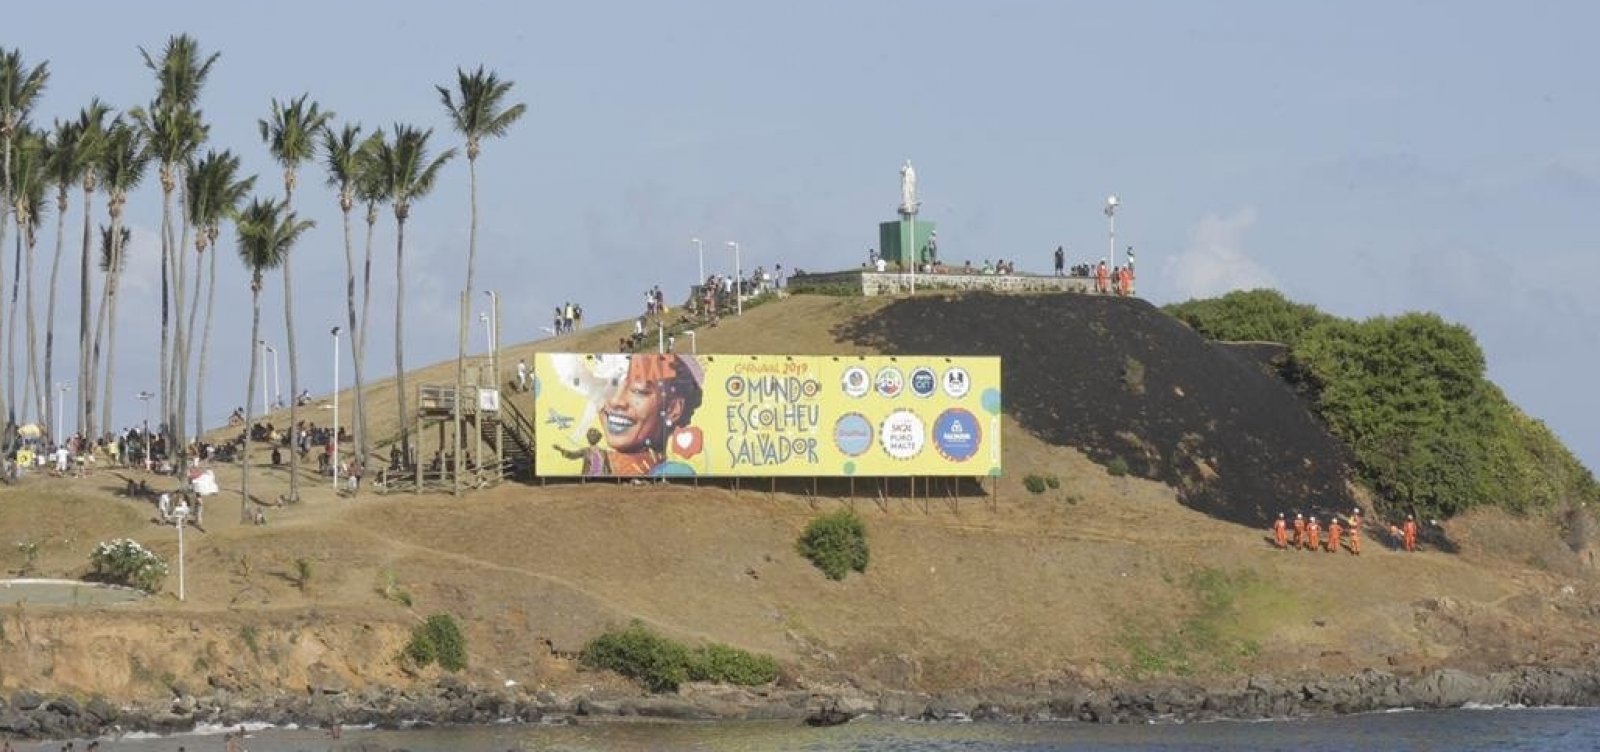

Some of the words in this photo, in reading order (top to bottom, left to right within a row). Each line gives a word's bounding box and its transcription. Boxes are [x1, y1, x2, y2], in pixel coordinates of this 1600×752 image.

[782, 362, 808, 375] 2019
[747, 375, 819, 403] MUNDO
[726, 403, 819, 435] ESCOLHEU
[726, 433, 819, 468] SALVADOR
